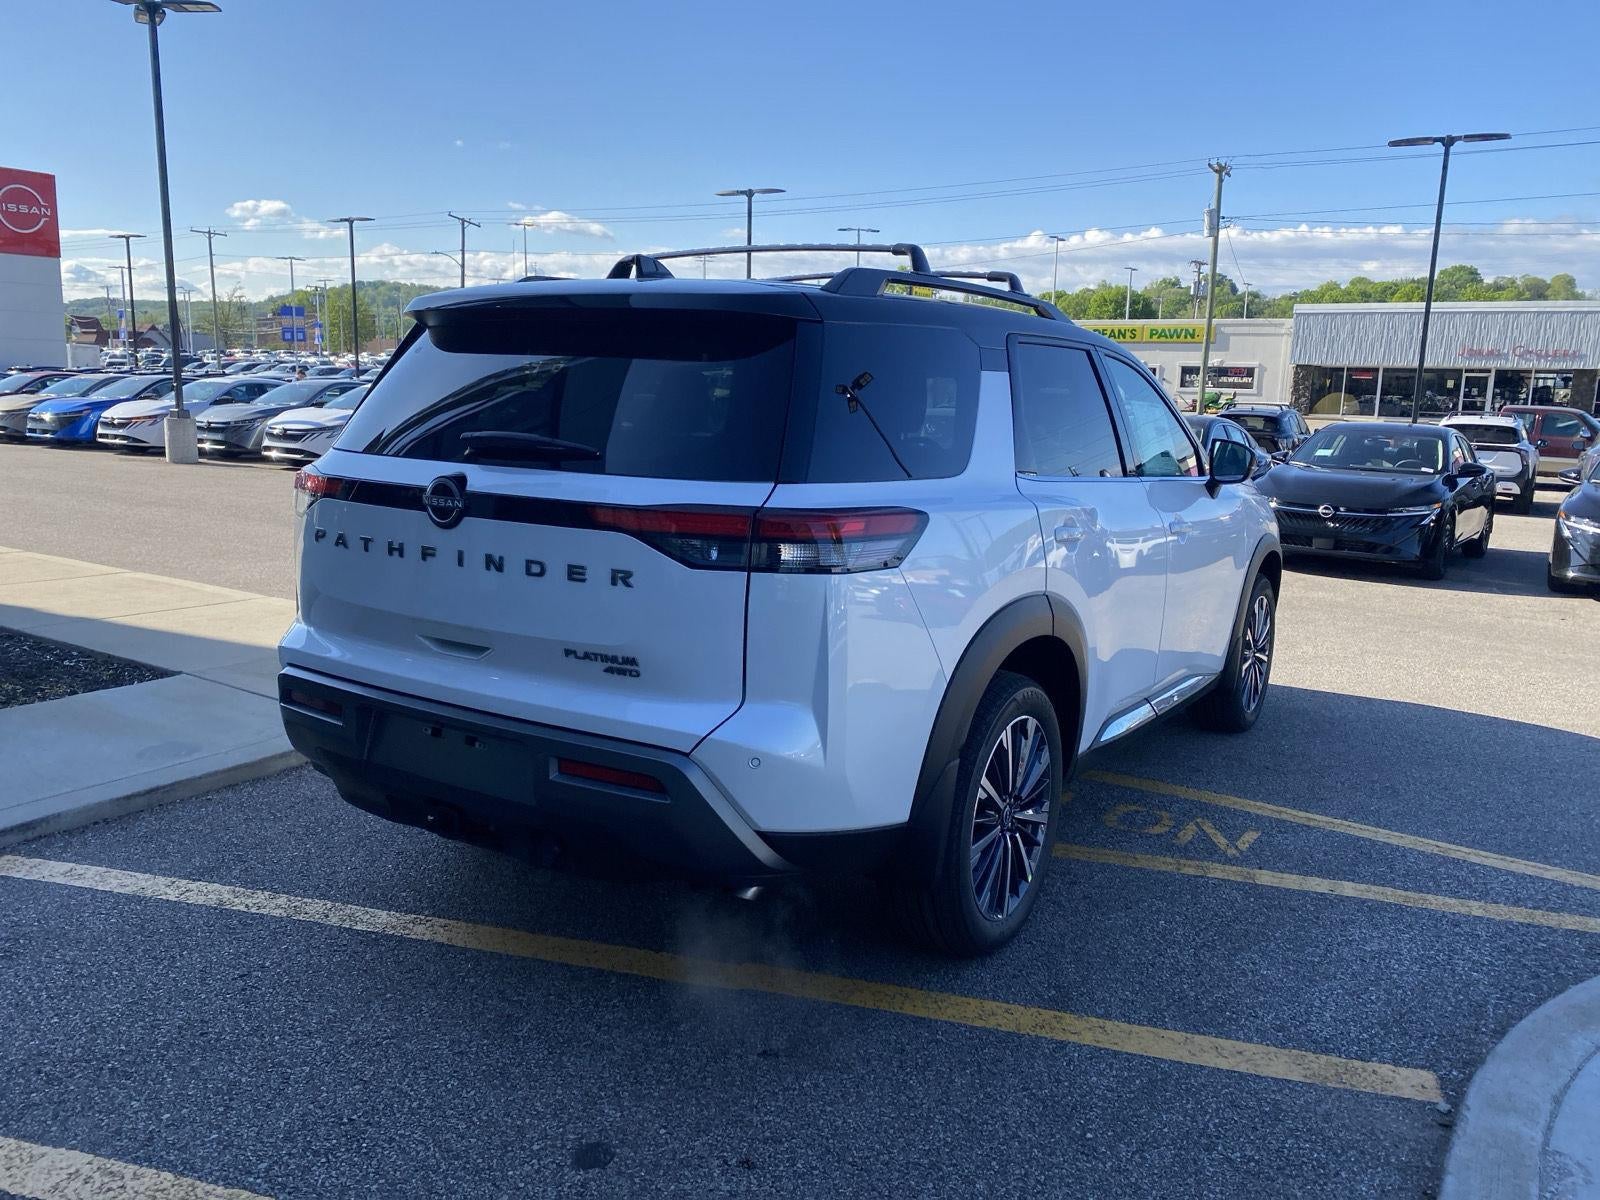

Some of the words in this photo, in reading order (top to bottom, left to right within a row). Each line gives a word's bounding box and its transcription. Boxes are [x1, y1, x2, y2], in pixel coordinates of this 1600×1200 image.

[2, 203, 51, 216] ISSAN
[422, 494, 463, 508] NISSAN
[314, 527, 635, 588] PATHFINDER
[563, 648, 639, 667] PLATINUM
[603, 666, 641, 678] 4WD
